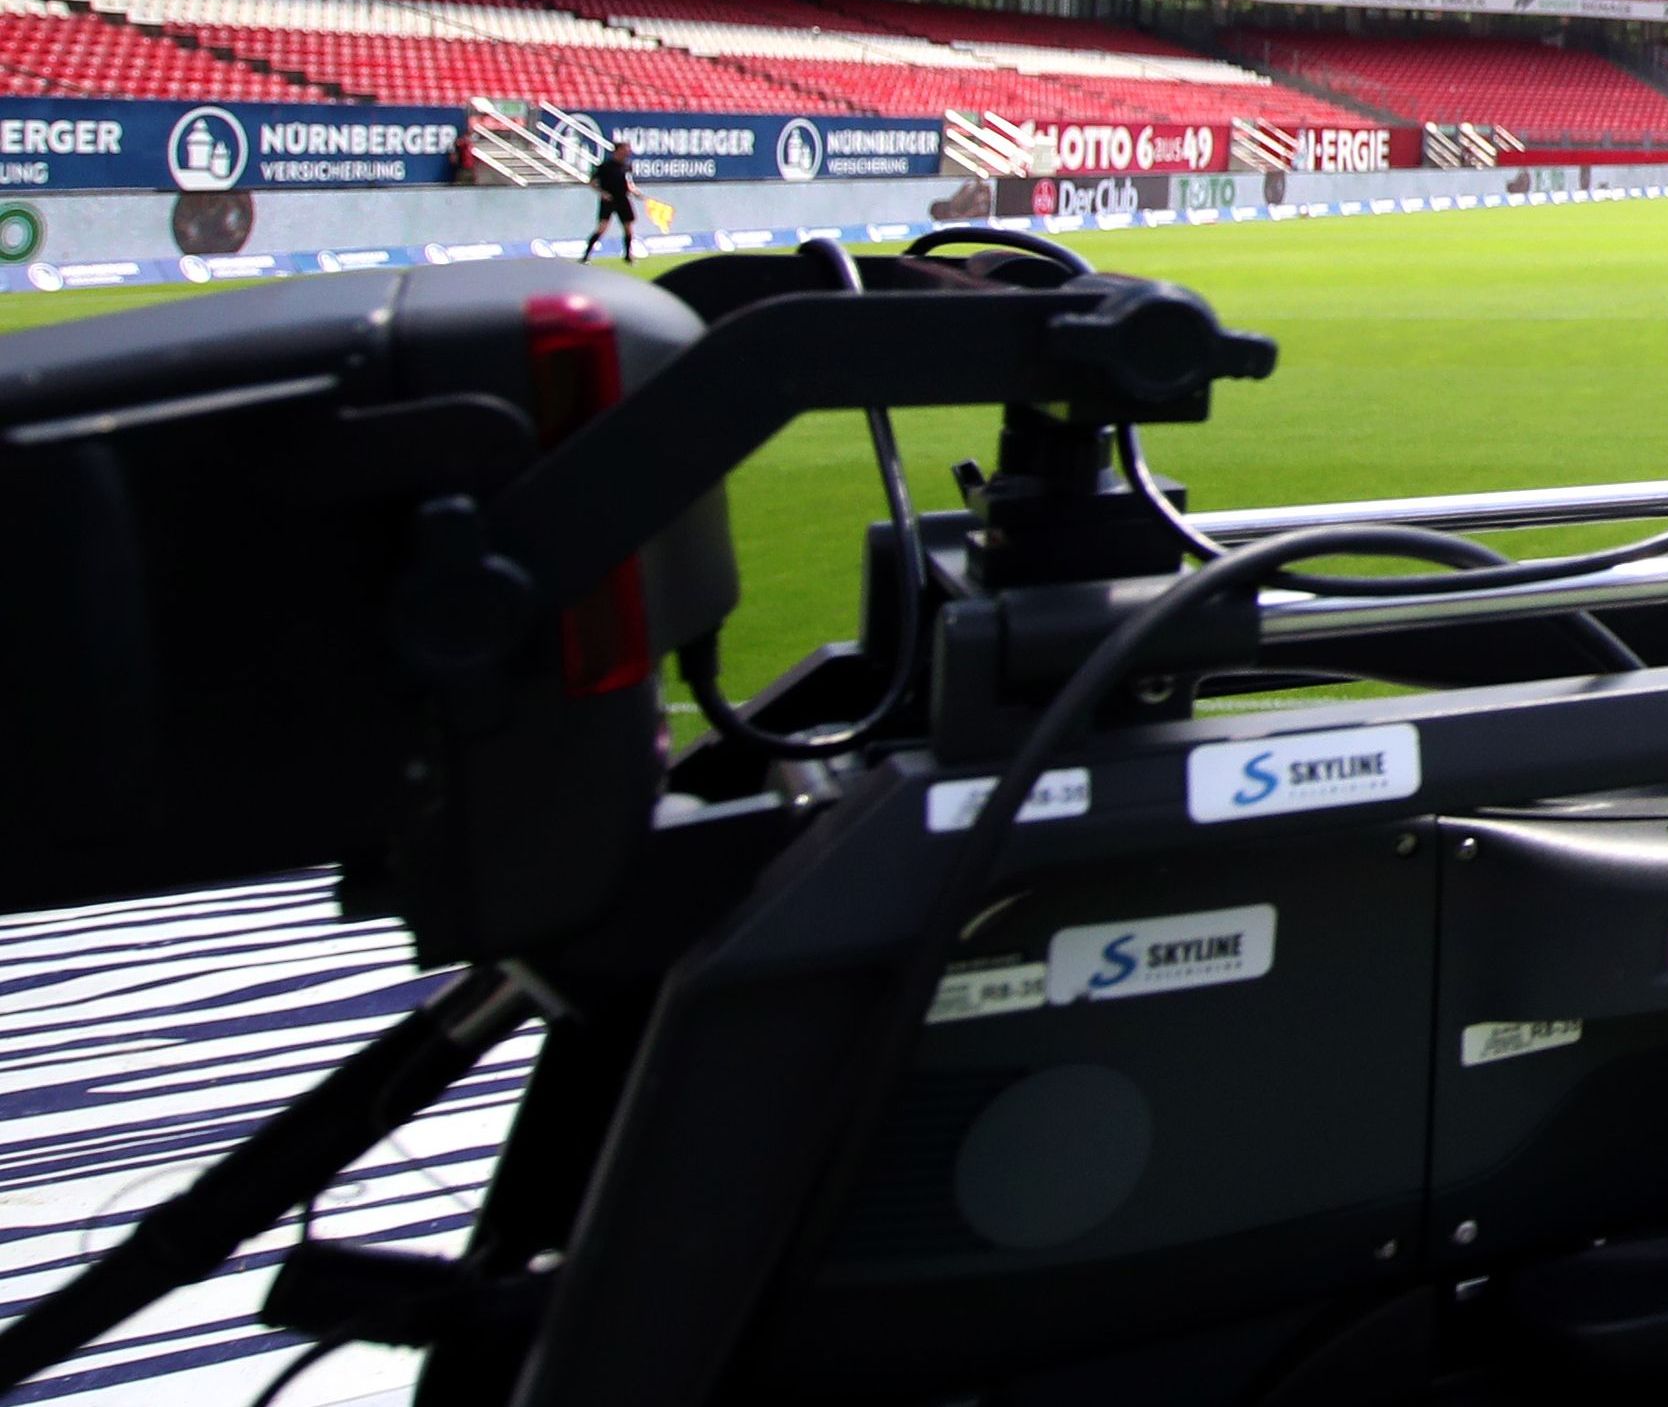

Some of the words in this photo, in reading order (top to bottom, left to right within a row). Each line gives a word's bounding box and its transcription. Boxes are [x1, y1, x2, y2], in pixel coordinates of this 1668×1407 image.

[260, 122, 458, 155] NÜRNBERGER
[826, 128, 940, 155] NÜRNBERGER
[260, 160, 406, 183] VERSICHERUNG
[1059, 180, 1095, 216] Der
[1095, 177, 1139, 216] Club
[1289, 752, 1385, 785] SKYLINE
[1147, 932, 1244, 968] SKYLINE
